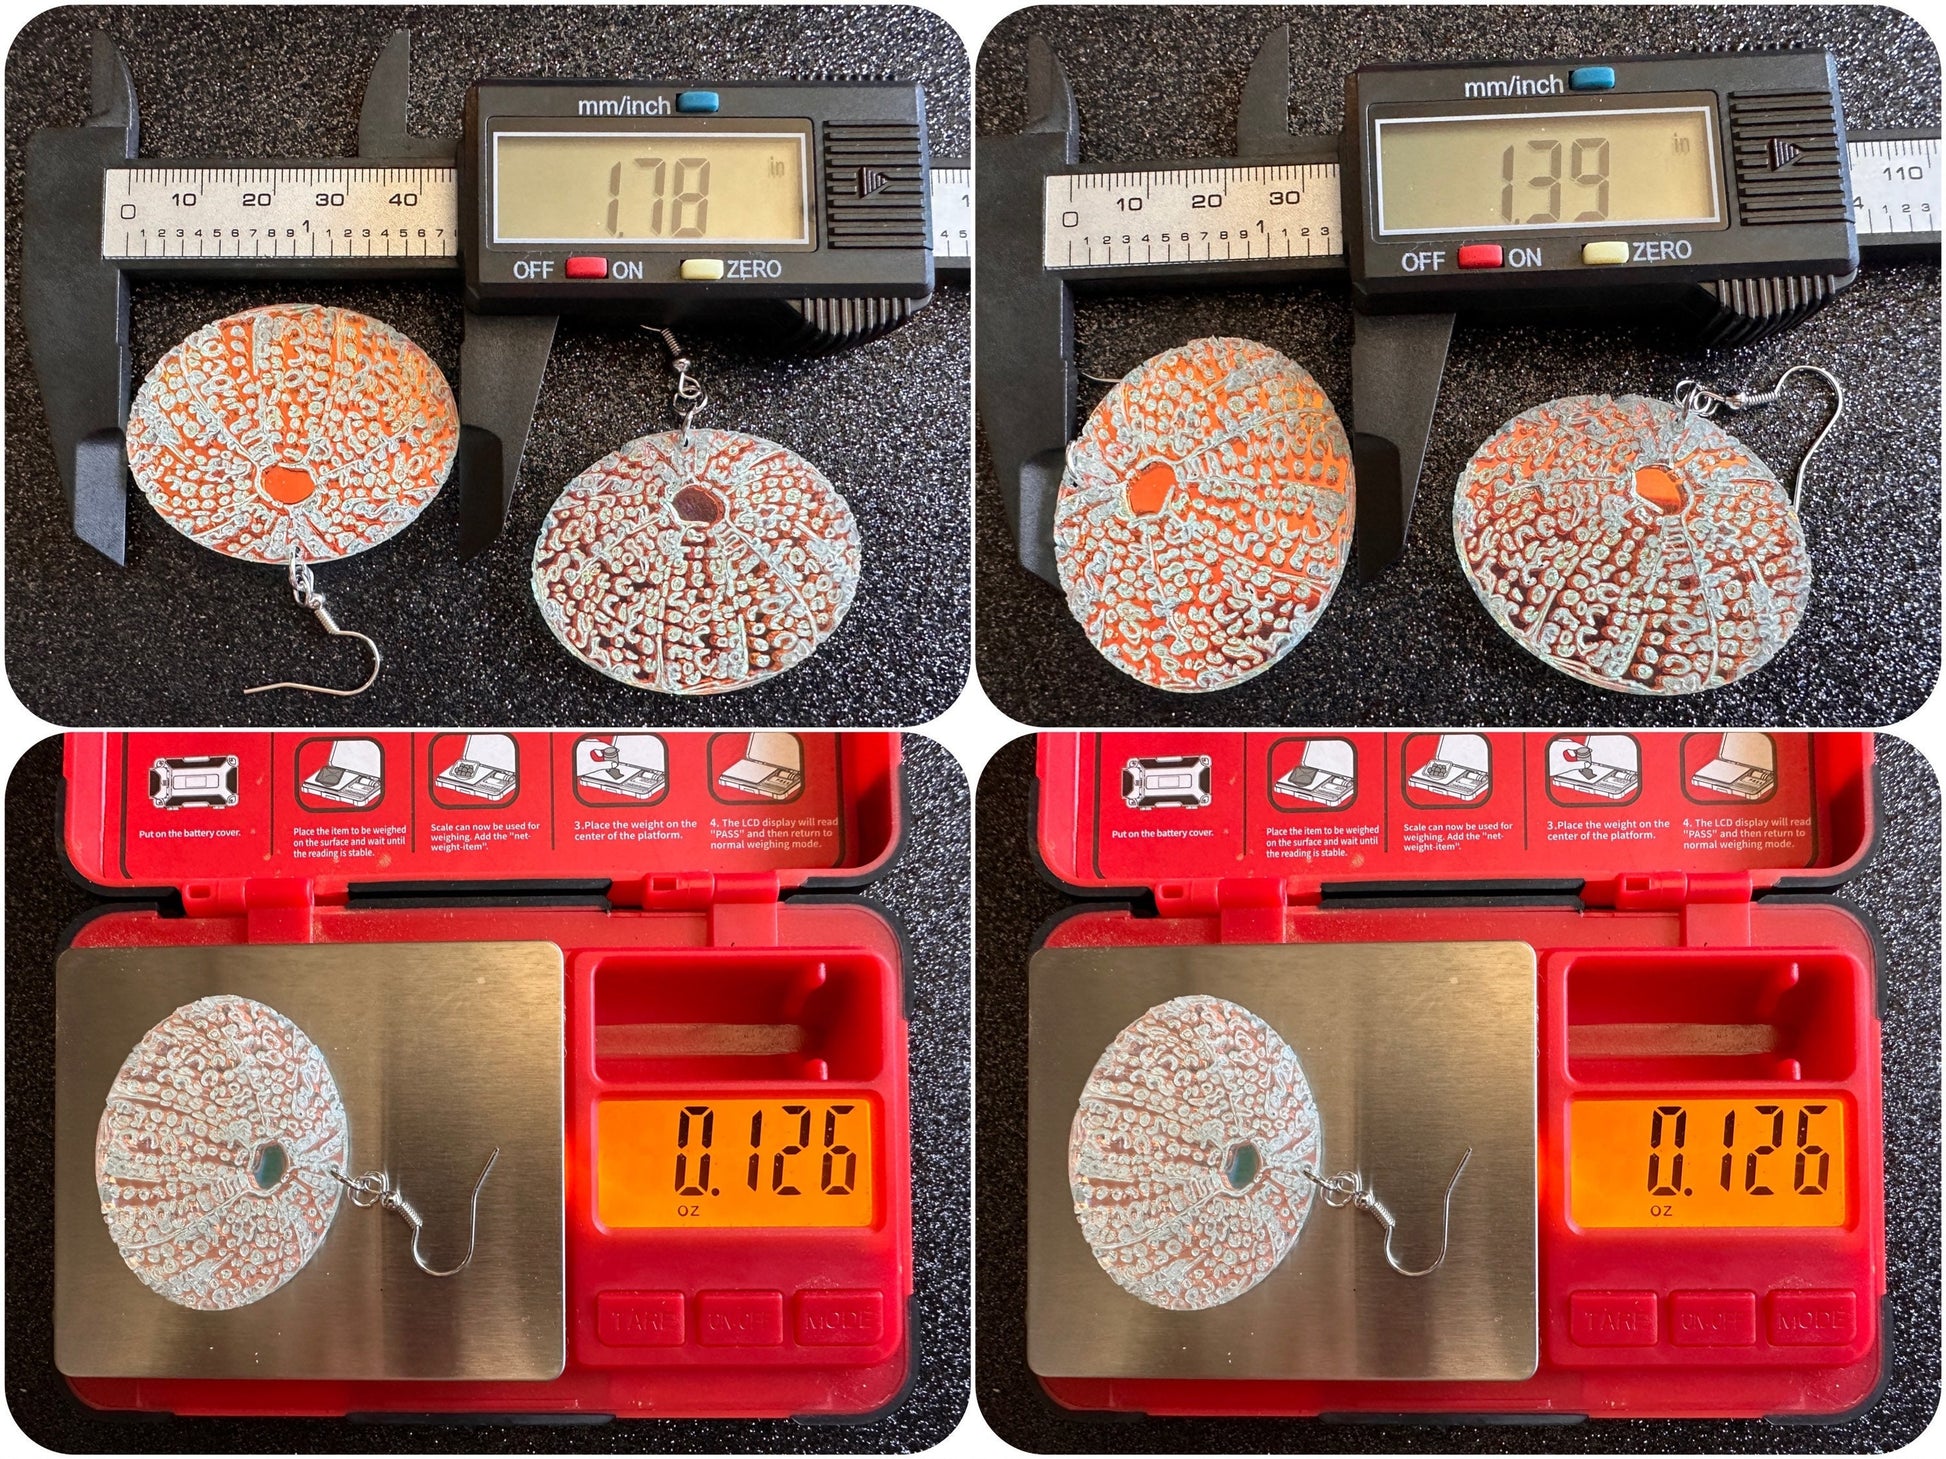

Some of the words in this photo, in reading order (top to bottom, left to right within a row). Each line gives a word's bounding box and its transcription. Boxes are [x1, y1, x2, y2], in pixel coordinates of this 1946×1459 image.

[1464, 75, 1564, 98] mm/inch
[578, 96, 671, 116] mm/inch
[1674, 132, 1690, 155] in
[769, 156, 785, 178] in
[1883, 166, 1923, 180] 110
[1501, 137, 1610, 225] 1.39
[172, 193, 196, 206] 10
[243, 193, 271, 206] 20
[316, 193, 344, 206] 30
[389, 193, 417, 206] 40
[606, 157, 710, 238] 1.78
[1117, 197, 1142, 211] 10
[1192, 194, 1222, 209] 20
[1270, 191, 1300, 205] 30
[121, 204, 136, 220] 0
[1062, 211, 1078, 228] 0
[302, 220, 310, 233] 1
[1256, 220, 1264, 233] 1
[141, 229, 146, 238] 1
[158, 229, 166, 238] 2
[176, 229, 184, 238] 3
[195, 229, 203, 238] 4
[213, 229, 221, 238] 5
[231, 229, 239, 238] 6
[249, 229, 257, 238] 7
[267, 229, 276, 238] 8
[286, 229, 294, 238] 9
[1633, 240, 1692, 262] ZERO
[1401, 251, 1445, 272] OFF
[1509, 248, 1542, 268] ON
[513, 261, 554, 280] OFF
[613, 261, 643, 280] ON
[727, 260, 782, 279] ZERO
[431, 823, 453, 832] Scale
[493, 822, 503, 831] be
[505, 822, 525, 830] used
[528, 821, 540, 830] for
[612, 820, 628, 829] the
[631, 820, 663, 832] weight
[681, 819, 697, 828] the
[722, 818, 739, 827] The
[742, 818, 760, 827] LCD
[762, 817, 796, 830] display
[798, 817, 815, 826] will
[818, 816, 838, 826] read
[1404, 823, 1426, 832] Scale
[1466, 822, 1476, 831] be
[1478, 822, 1498, 830] used
[1501, 821, 1513, 830] for
[1585, 820, 1601, 829] the
[1604, 820, 1636, 832] weight
[1654, 819, 1670, 828] the
[1695, 818, 1712, 827] The
[1715, 818, 1733, 827] LCD
[1735, 817, 1769, 830] display
[1771, 817, 1788, 826] will
[1791, 816, 1811, 826] read
[139, 829, 154, 839] Put
[168, 829, 182, 838] the
[183, 828, 215, 841] battery
[293, 826, 315, 836] Place
[316, 826, 329, 835] the
[331, 826, 349, 835] item
[351, 827, 359, 835] to
[361, 825, 371, 834] be
[373, 825, 406, 838] weighed
[474, 832, 491, 841] Add
[493, 832, 507, 841] the
[574, 833, 605, 841] center
[607, 831, 617, 840] of
[619, 831, 635, 840] the
[747, 829, 764, 838] and
[767, 828, 788, 838] then
[791, 829, 820, 837] return
[823, 829, 832, 837] to
[1112, 829, 1127, 839] Put
[1141, 829, 1155, 838] the
[1156, 828, 1188, 841] battery
[1266, 826, 1288, 836] Place
[1289, 826, 1302, 835] the
[1304, 826, 1322, 835] item
[1324, 827, 1332, 835] to
[1334, 825, 1344, 834] be
[1346, 825, 1379, 838] weighed
[1447, 832, 1464, 841] Add
[1466, 832, 1480, 841] the
[1547, 833, 1578, 841] center
[1580, 831, 1590, 840] of
[1592, 831, 1608, 840] the
[1720, 829, 1737, 838] and
[1740, 828, 1761, 838] then
[1764, 829, 1793, 837] return
[1796, 829, 1805, 837] to
[293, 839, 303, 847] on
[305, 837, 319, 847] the
[320, 836, 349, 846] surface
[351, 836, 366, 846] and
[367, 836, 385, 845] wait
[387, 834, 405, 845] until
[711, 840, 744, 849] normal
[747, 839, 789, 852] weighing
[1266, 839, 1276, 847] on
[1278, 837, 1292, 847] the
[1293, 836, 1322, 846] surface
[1324, 836, 1339, 846] and
[1340, 836, 1358, 845] wait
[1360, 834, 1378, 845] until
[1684, 840, 1717, 849] normal
[1720, 839, 1762, 852] weighing
[293, 848, 307, 858] the
[308, 848, 339, 861] reading
[340, 848, 347, 857] is
[1266, 848, 1280, 858] the
[1281, 848, 1312, 861] reading
[1313, 848, 1320, 857] is
[675, 1105, 856, 1196] 0.126
[1648, 1105, 1829, 1196] 0.126
[804, 1311, 873, 1330] MODE
[1777, 1311, 1846, 1330] MODE
